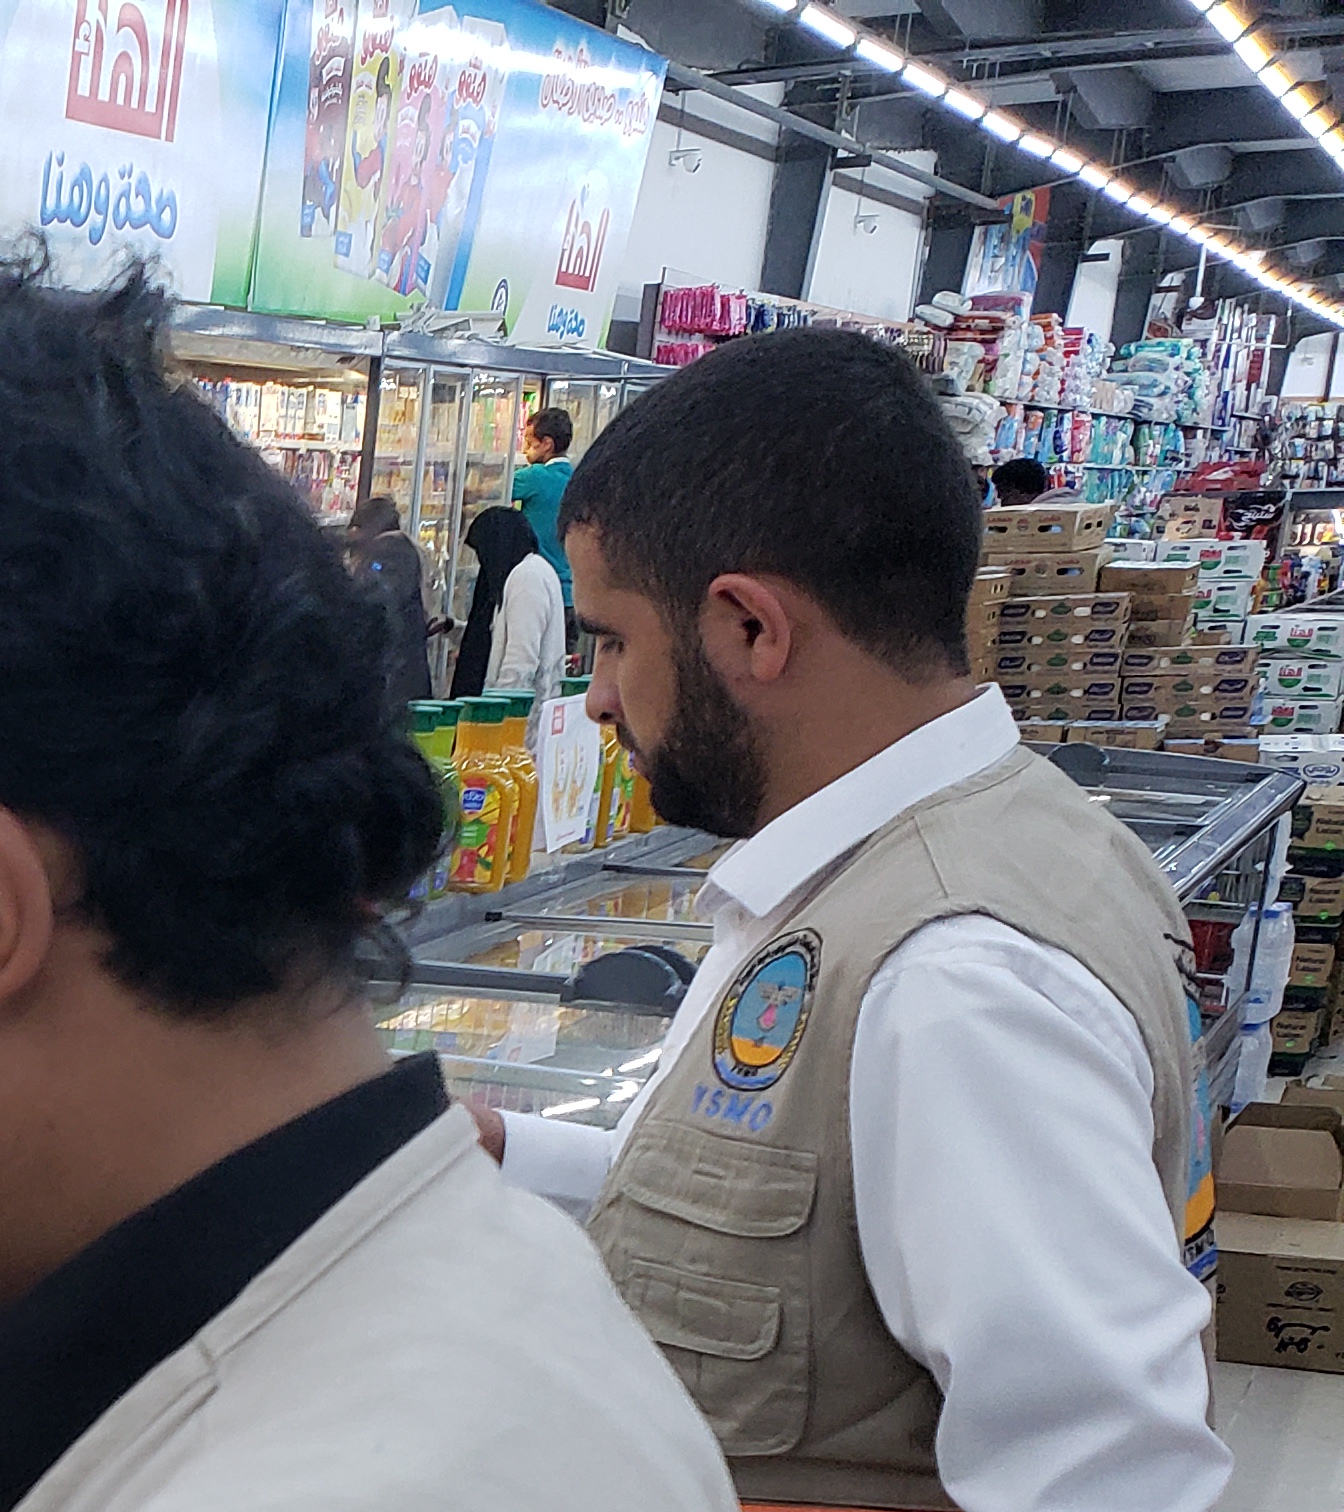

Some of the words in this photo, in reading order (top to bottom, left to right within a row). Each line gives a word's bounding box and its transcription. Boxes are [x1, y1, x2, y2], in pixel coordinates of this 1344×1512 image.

[39, 150, 111, 246] وهنا
[112, 162, 178, 240] صحة
[691, 1084, 774, 1133] YSMO
